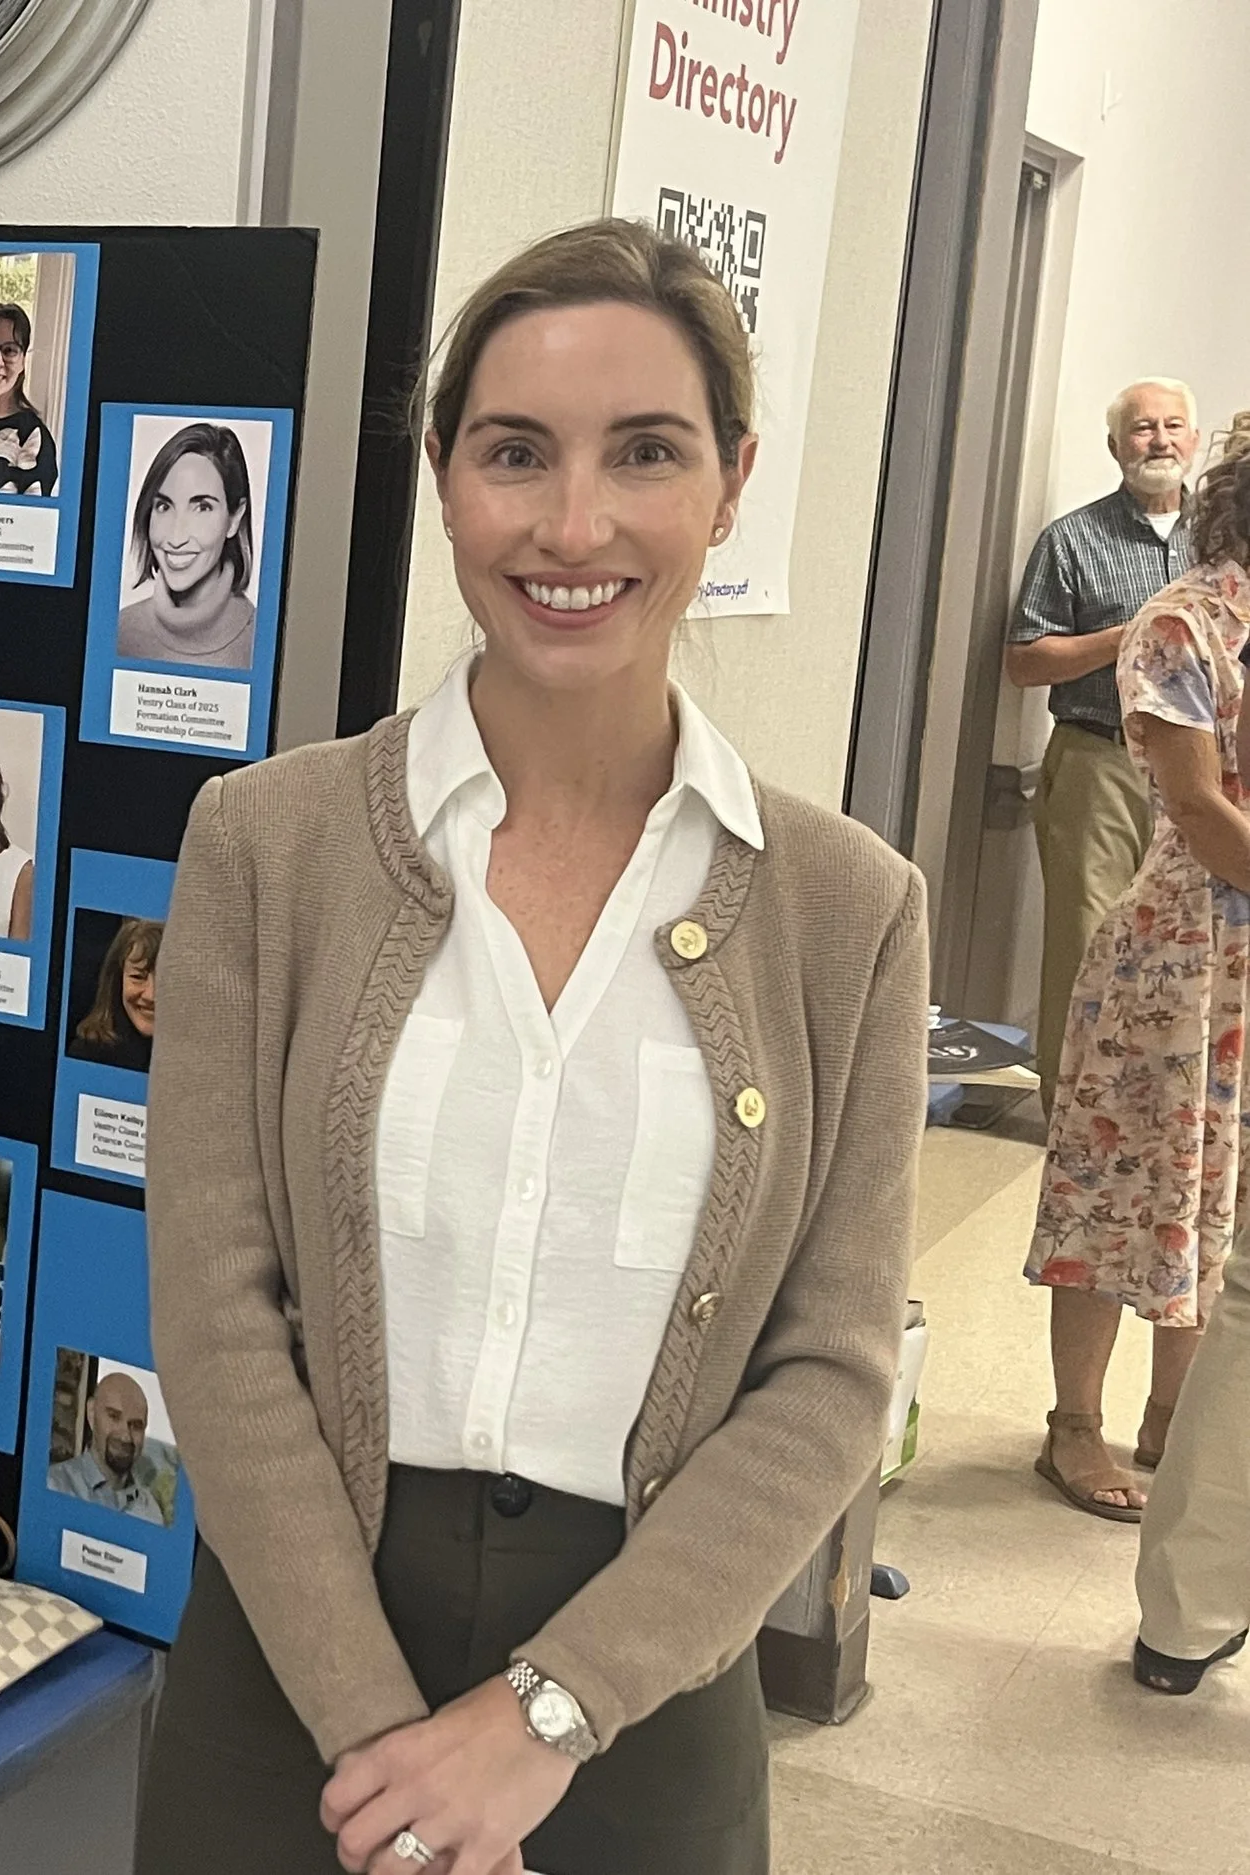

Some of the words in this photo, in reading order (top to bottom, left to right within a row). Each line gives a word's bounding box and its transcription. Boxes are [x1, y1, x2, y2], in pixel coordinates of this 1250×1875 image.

[650, 21, 797, 164] Directory
[138, 684, 171, 694] Hannah
[174, 687, 197, 697] Clark
[137, 696, 163, 709] Vestry
[165, 699, 186, 709] Class
[188, 702, 197, 710] of
[198, 702, 219, 712] 2025
[137, 709, 179, 721] Formation
[181, 714, 225, 726] Committee
